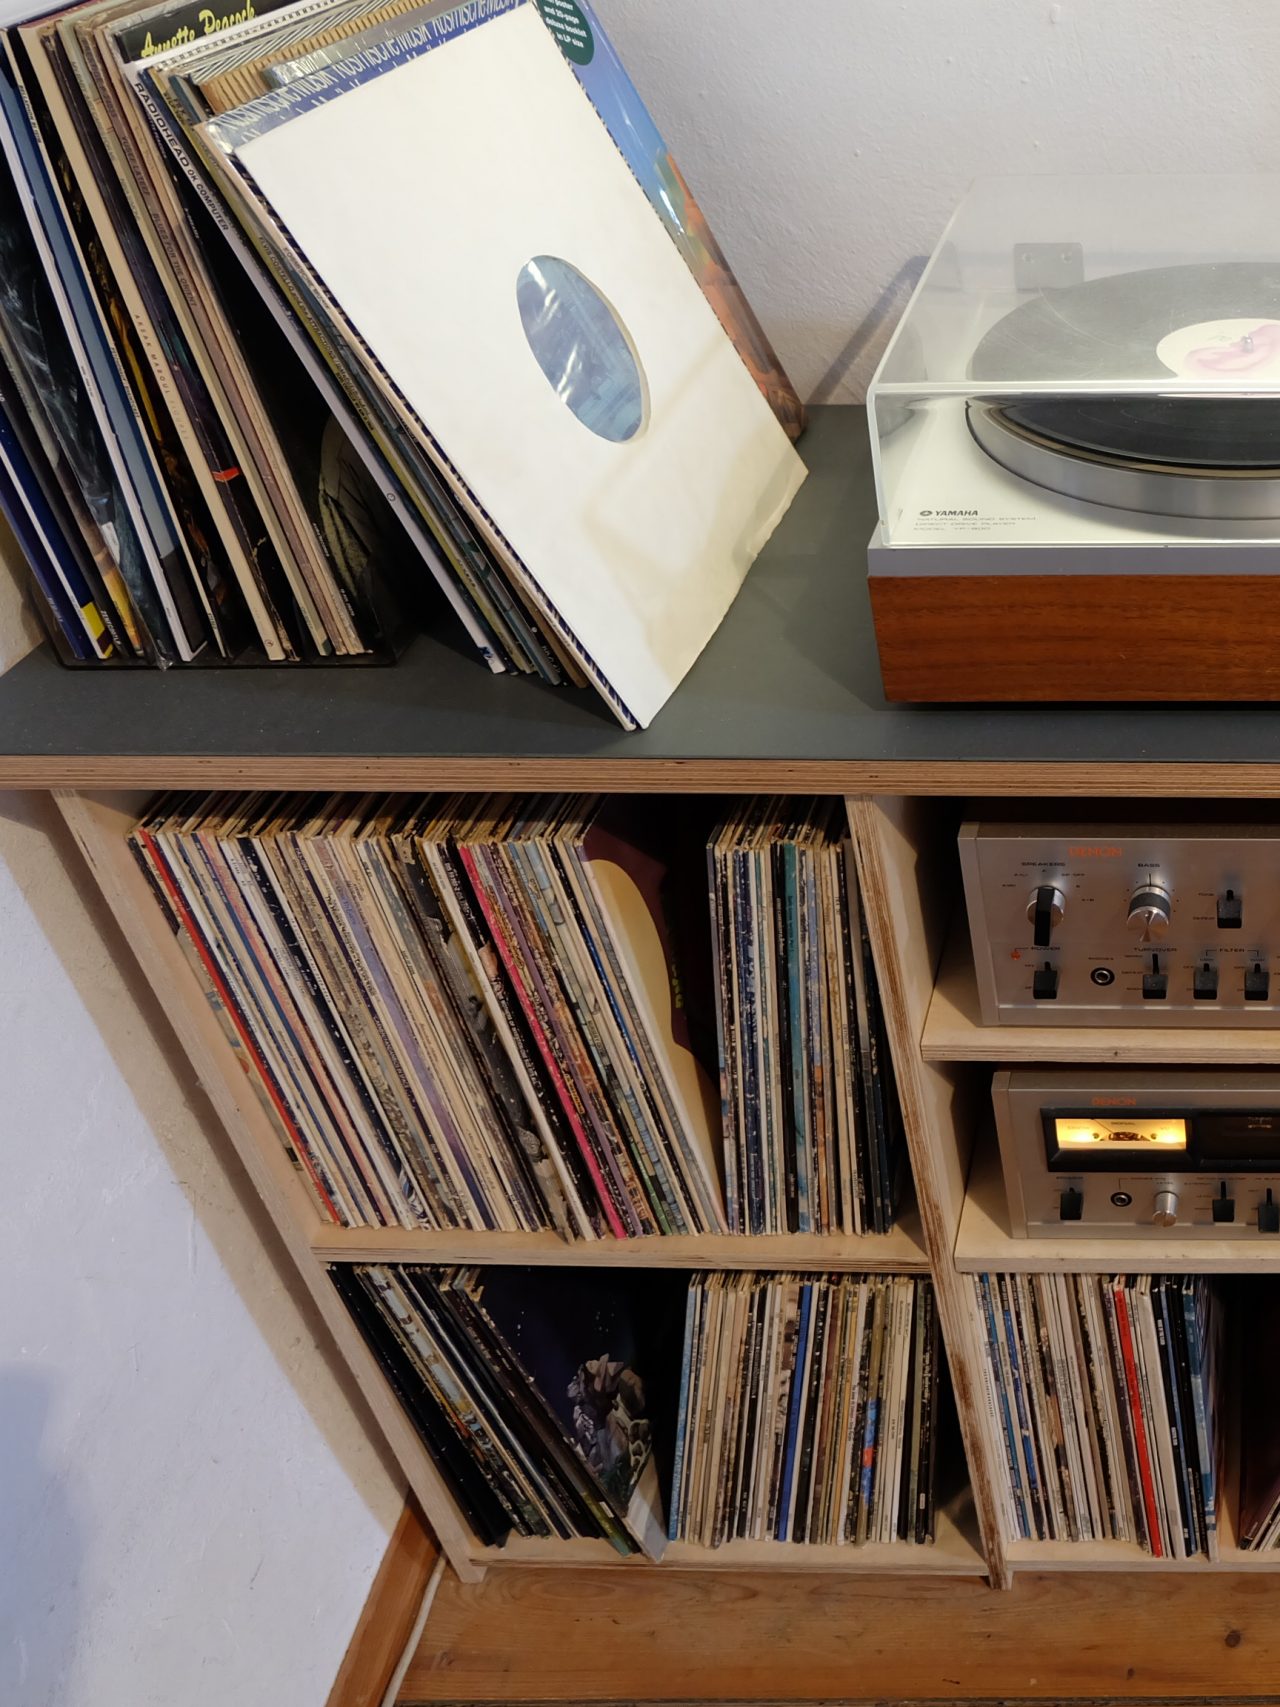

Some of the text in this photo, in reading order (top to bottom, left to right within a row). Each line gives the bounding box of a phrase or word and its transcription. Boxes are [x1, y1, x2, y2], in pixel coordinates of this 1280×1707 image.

[141, 25, 196, 58] Annette
[133, 80, 229, 232] RADIOHEAD OK COMPUTER
[119, 134, 198, 307] YUSEF LATEEF BLUES FOR THE ORIENT
[133, 313, 152, 349] AKSAK
[150, 352, 171, 394] MABOUL
[1068, 847, 1123, 858] DENON
[324, 895, 333, 906] The
[1092, 1097, 1136, 1106] DENON
